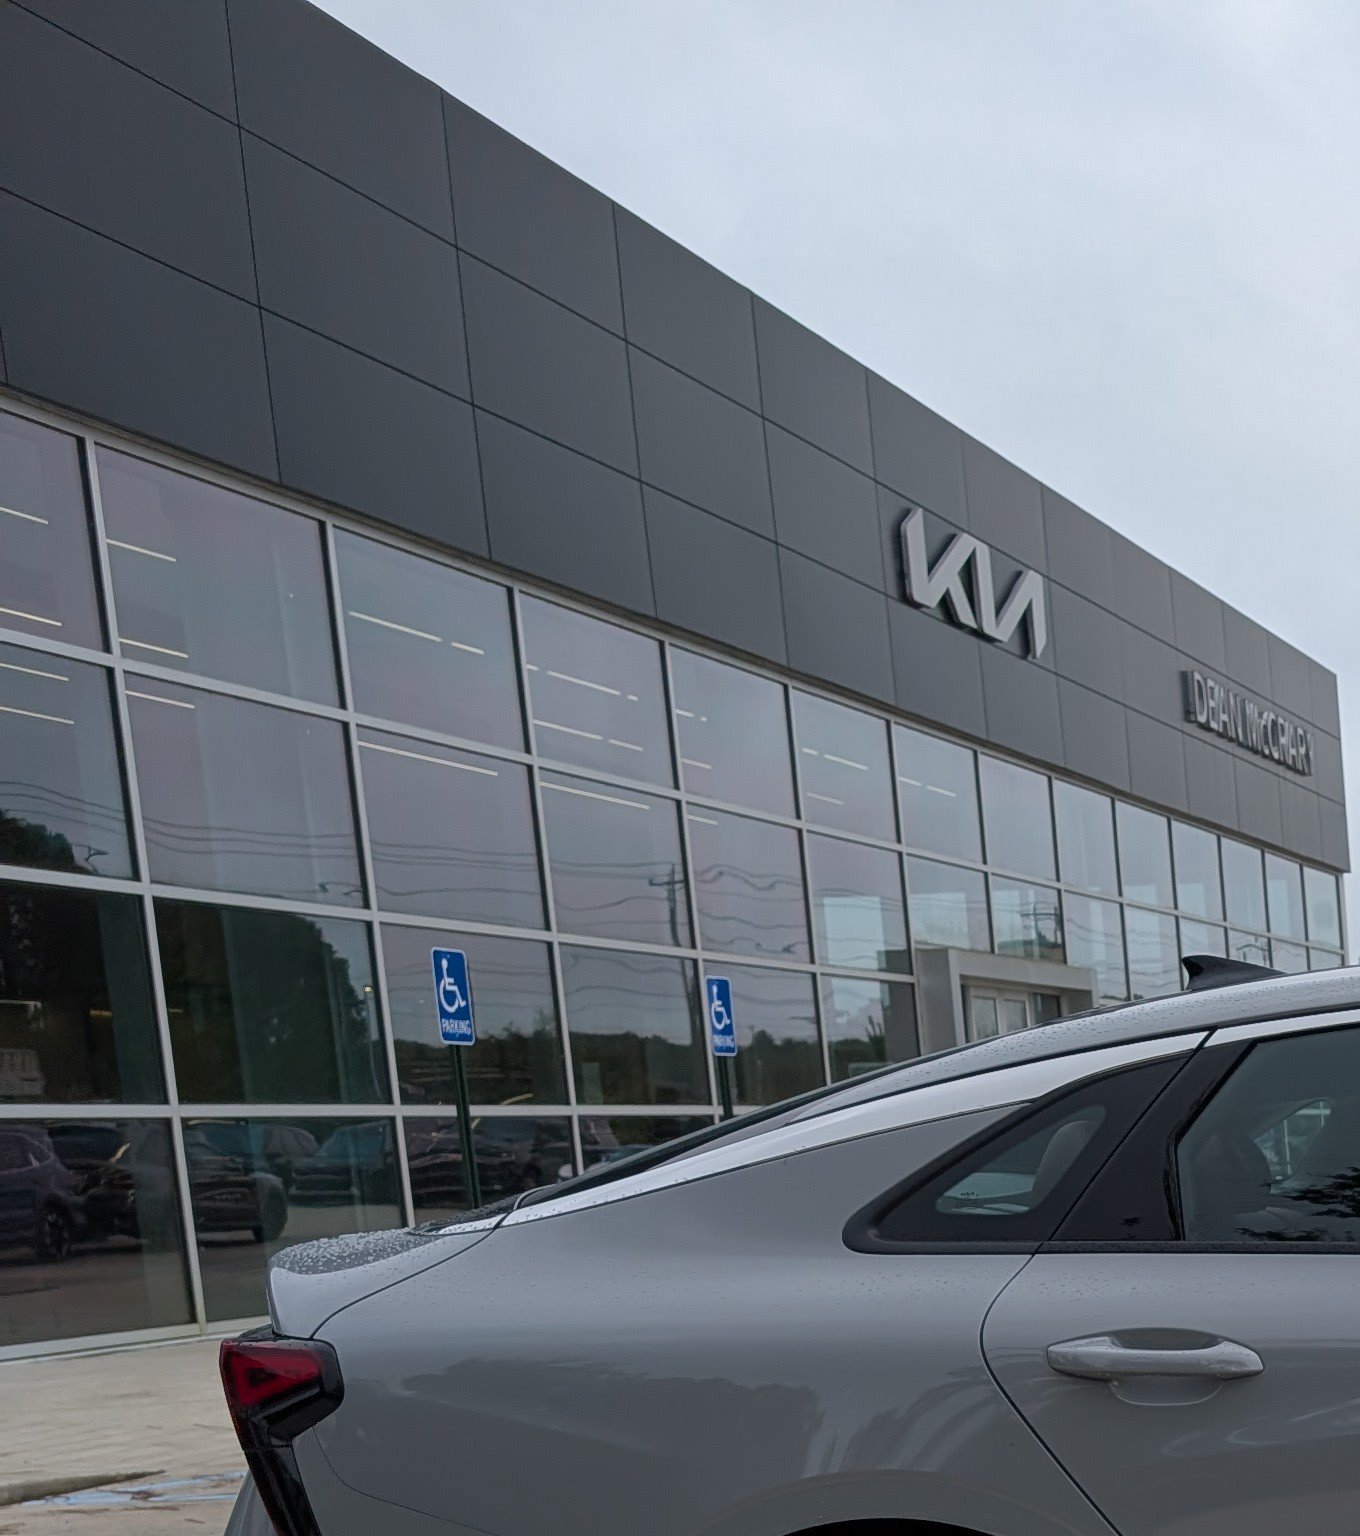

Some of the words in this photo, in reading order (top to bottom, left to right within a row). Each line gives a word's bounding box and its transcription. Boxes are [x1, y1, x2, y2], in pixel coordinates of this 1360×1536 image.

[900, 508, 1047, 659] KIA
[1192, 670, 1244, 742] DEAN
[441, 1018, 471, 1035] PARKING
